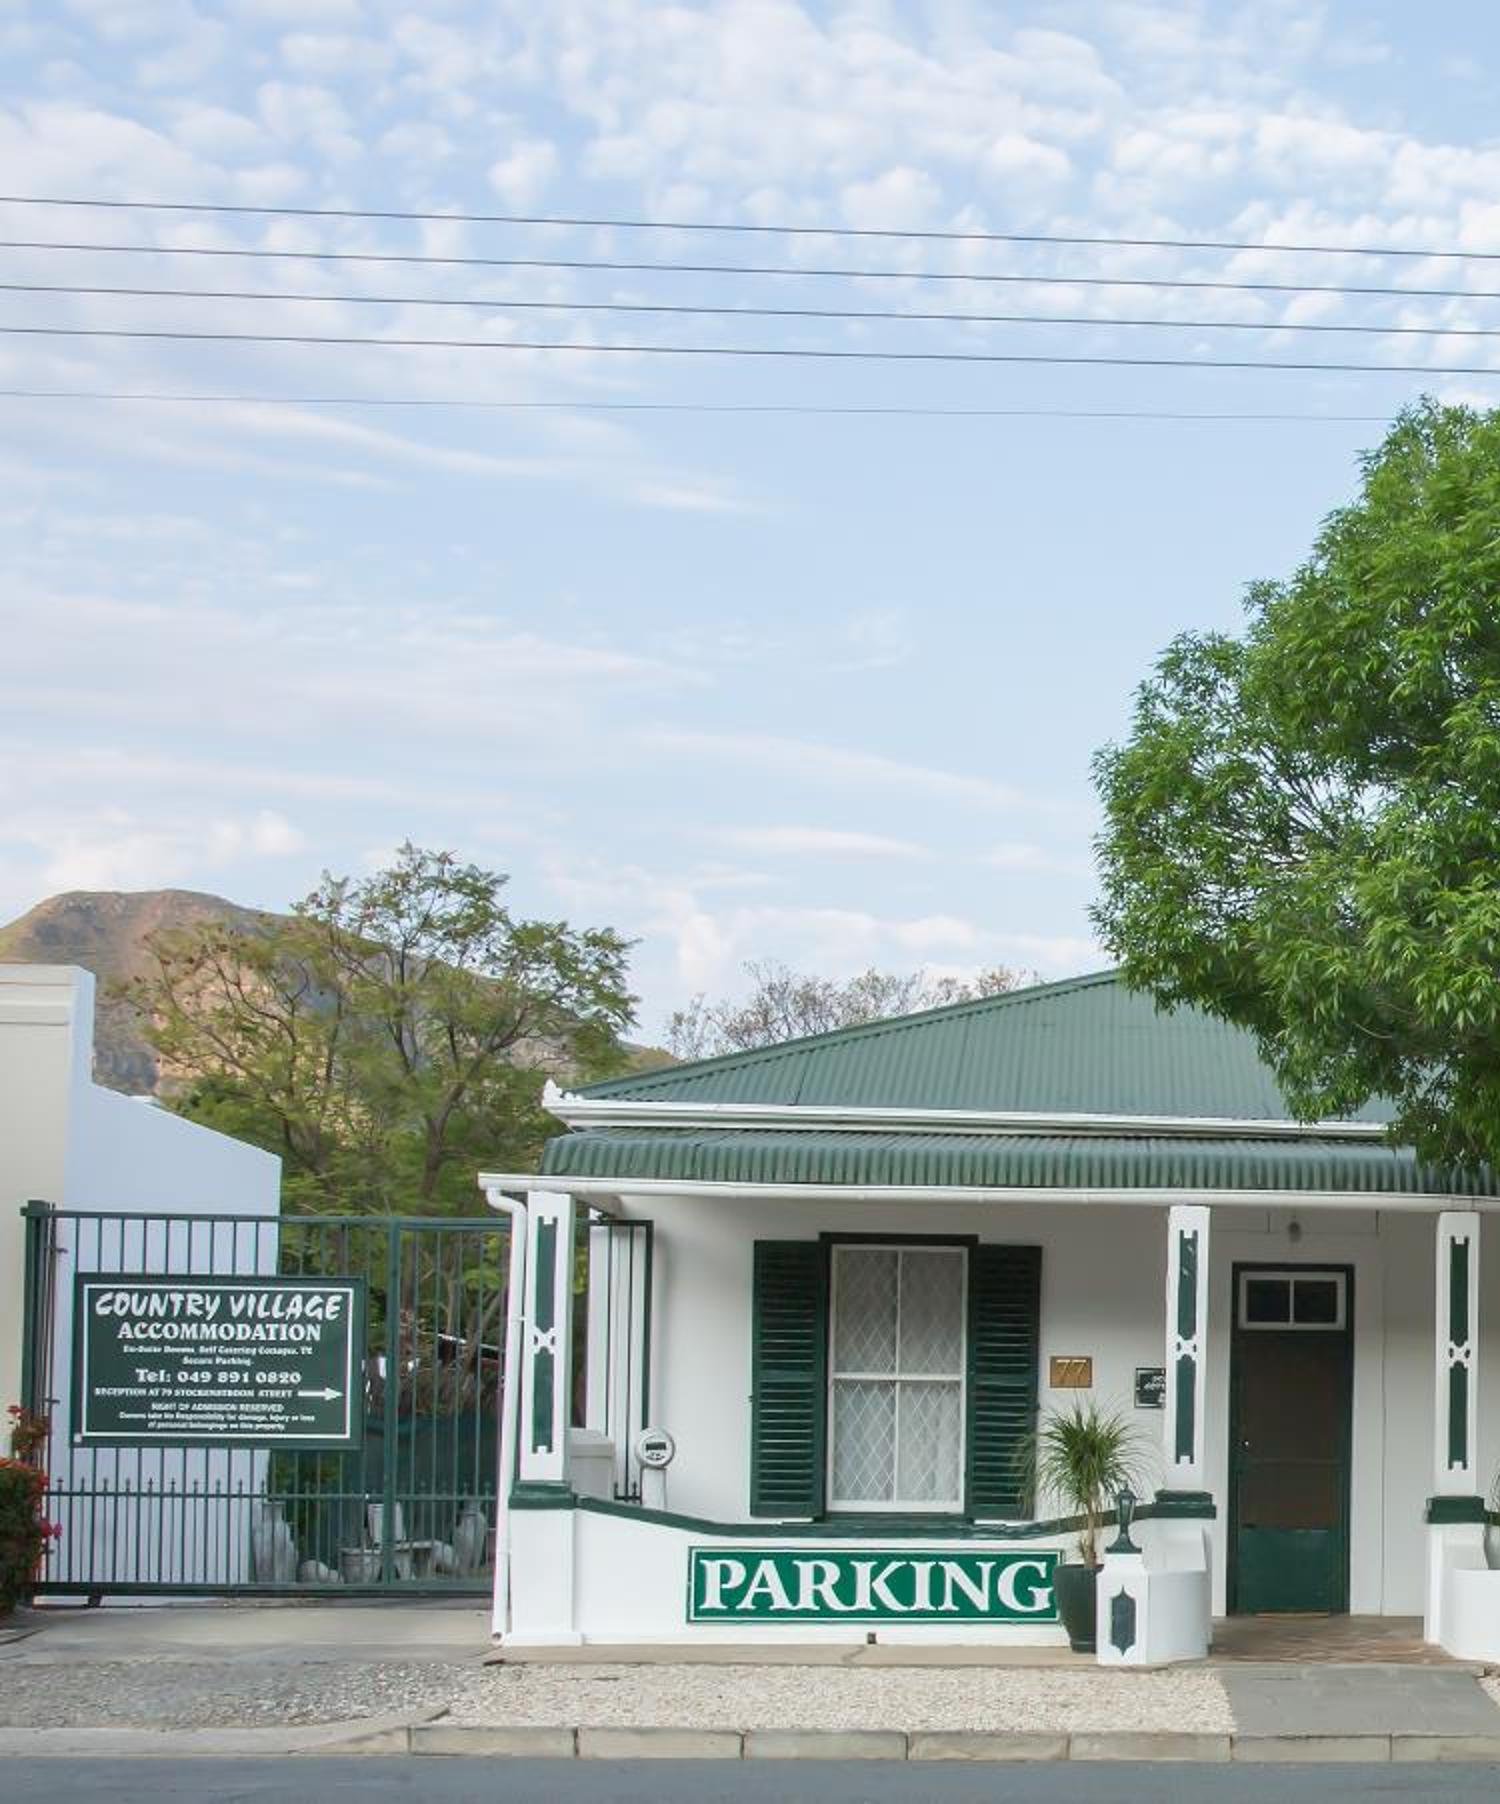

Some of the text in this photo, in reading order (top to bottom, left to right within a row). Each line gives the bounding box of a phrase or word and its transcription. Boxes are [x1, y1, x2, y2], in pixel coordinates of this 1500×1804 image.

[95, 1291, 343, 1320] COUNTRY VILLAGE
[117, 1321, 321, 1341] ACCOMMODATION
[135, 1368, 302, 1385] Tel: 049 891 0820
[1055, 1358, 1088, 1384] 77
[94, 1387, 147, 1397] RECEPTION
[148, 1388, 160, 1397] AT
[258, 1389, 293, 1398] STREET
[699, 1558, 1054, 1613] PARKING
